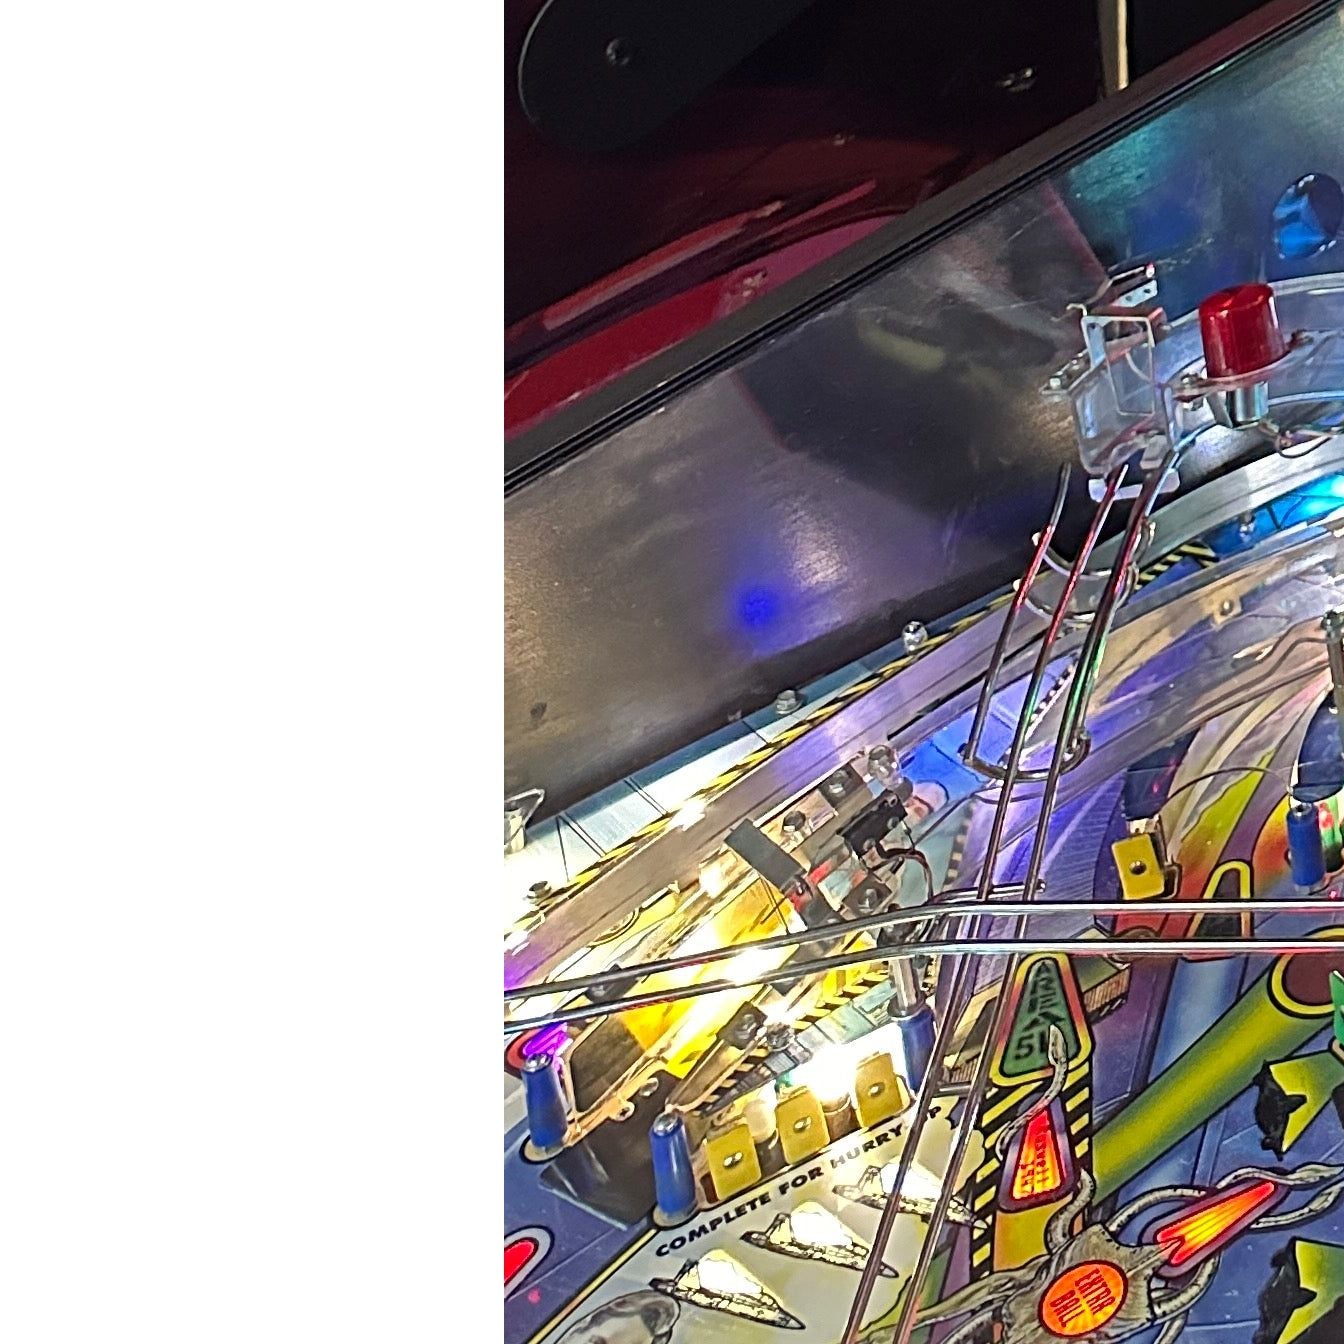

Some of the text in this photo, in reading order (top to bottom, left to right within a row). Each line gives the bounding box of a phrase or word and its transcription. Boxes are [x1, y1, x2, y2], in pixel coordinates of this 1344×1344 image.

[655, 1191, 772, 1258] COMPLETE
[778, 1166, 825, 1196] FOR
[829, 1122, 903, 1168] HURRY
[1049, 1289, 1086, 1328] BALL
[1074, 1268, 1116, 1316] EXTRA
